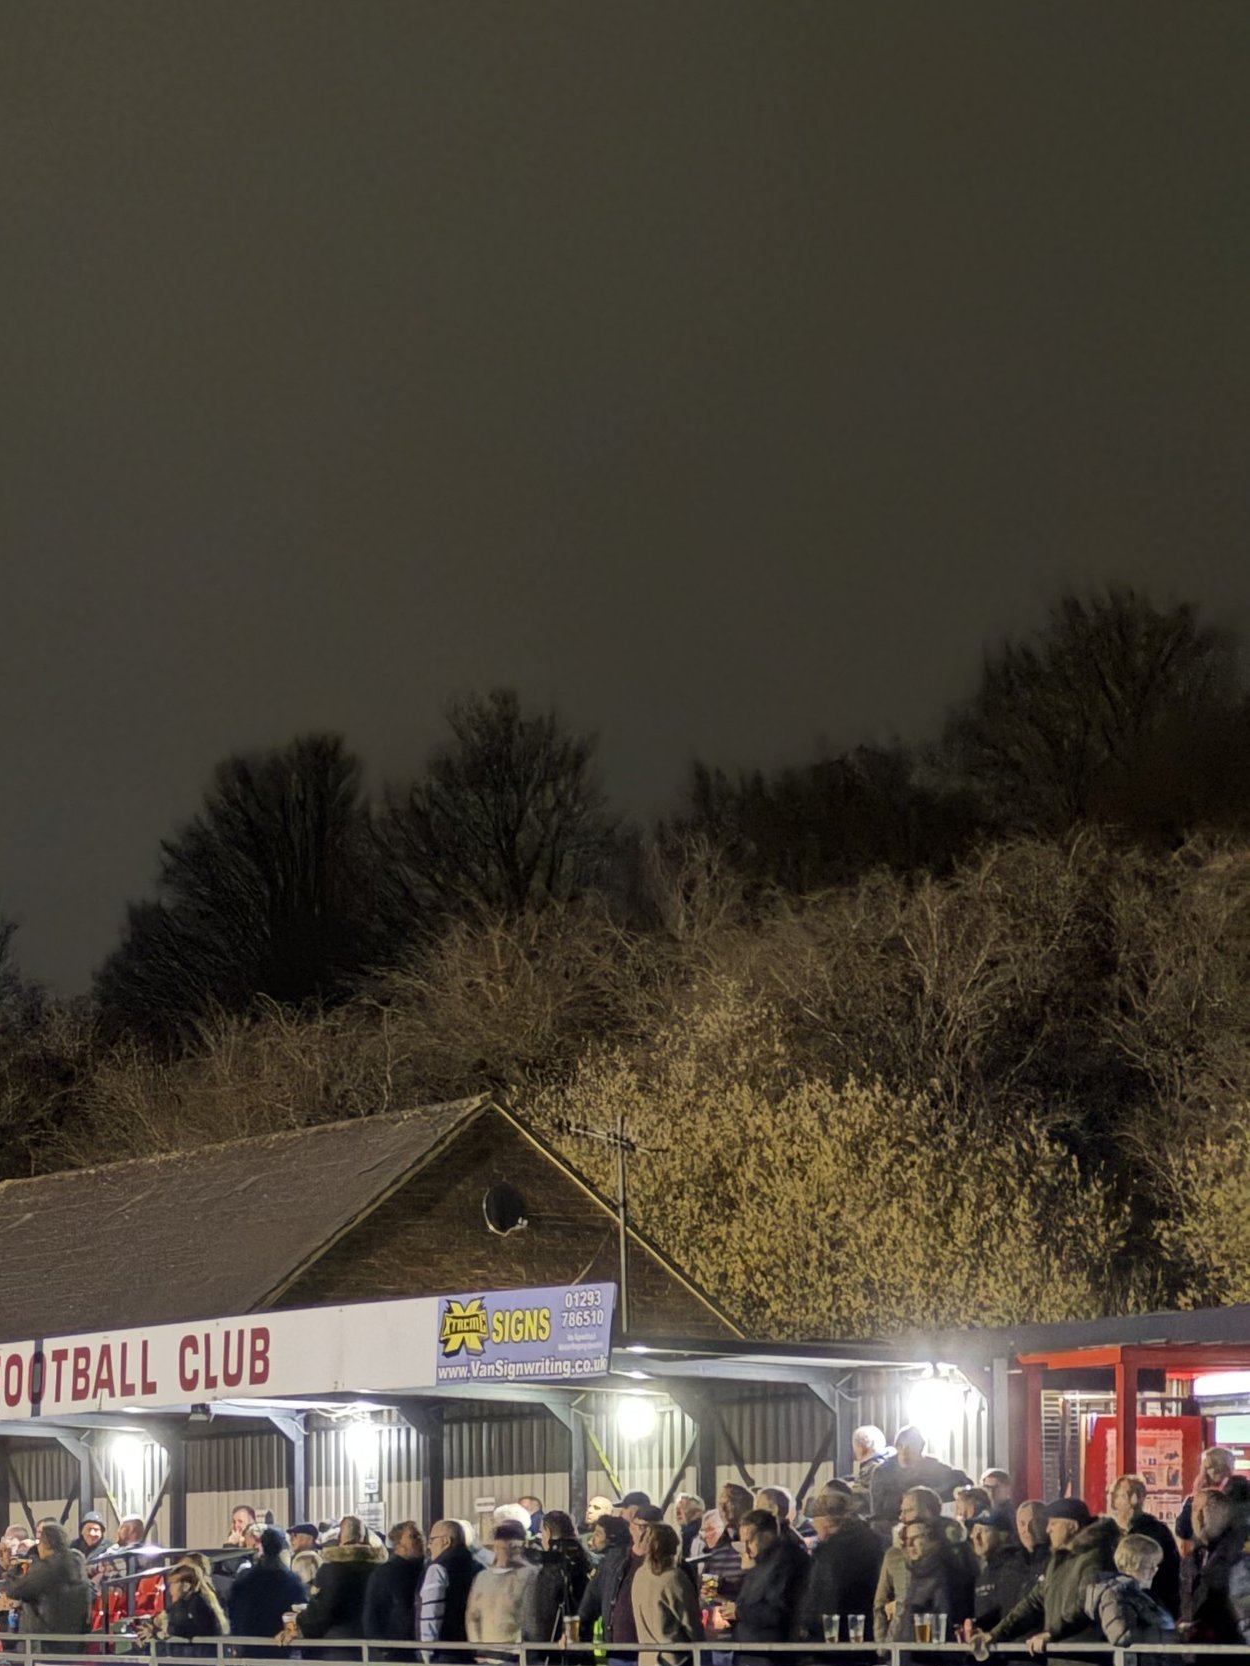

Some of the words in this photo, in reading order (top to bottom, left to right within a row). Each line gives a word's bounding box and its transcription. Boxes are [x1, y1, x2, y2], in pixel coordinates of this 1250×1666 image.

[565, 1290, 601, 1308] 01293
[492, 1308, 550, 1344] SIGNS
[561, 1309, 604, 1327] 786510
[178, 1327, 270, 1393] CLUB
[438, 1354, 607, 1380] www.VanSignwriting.co.uk
